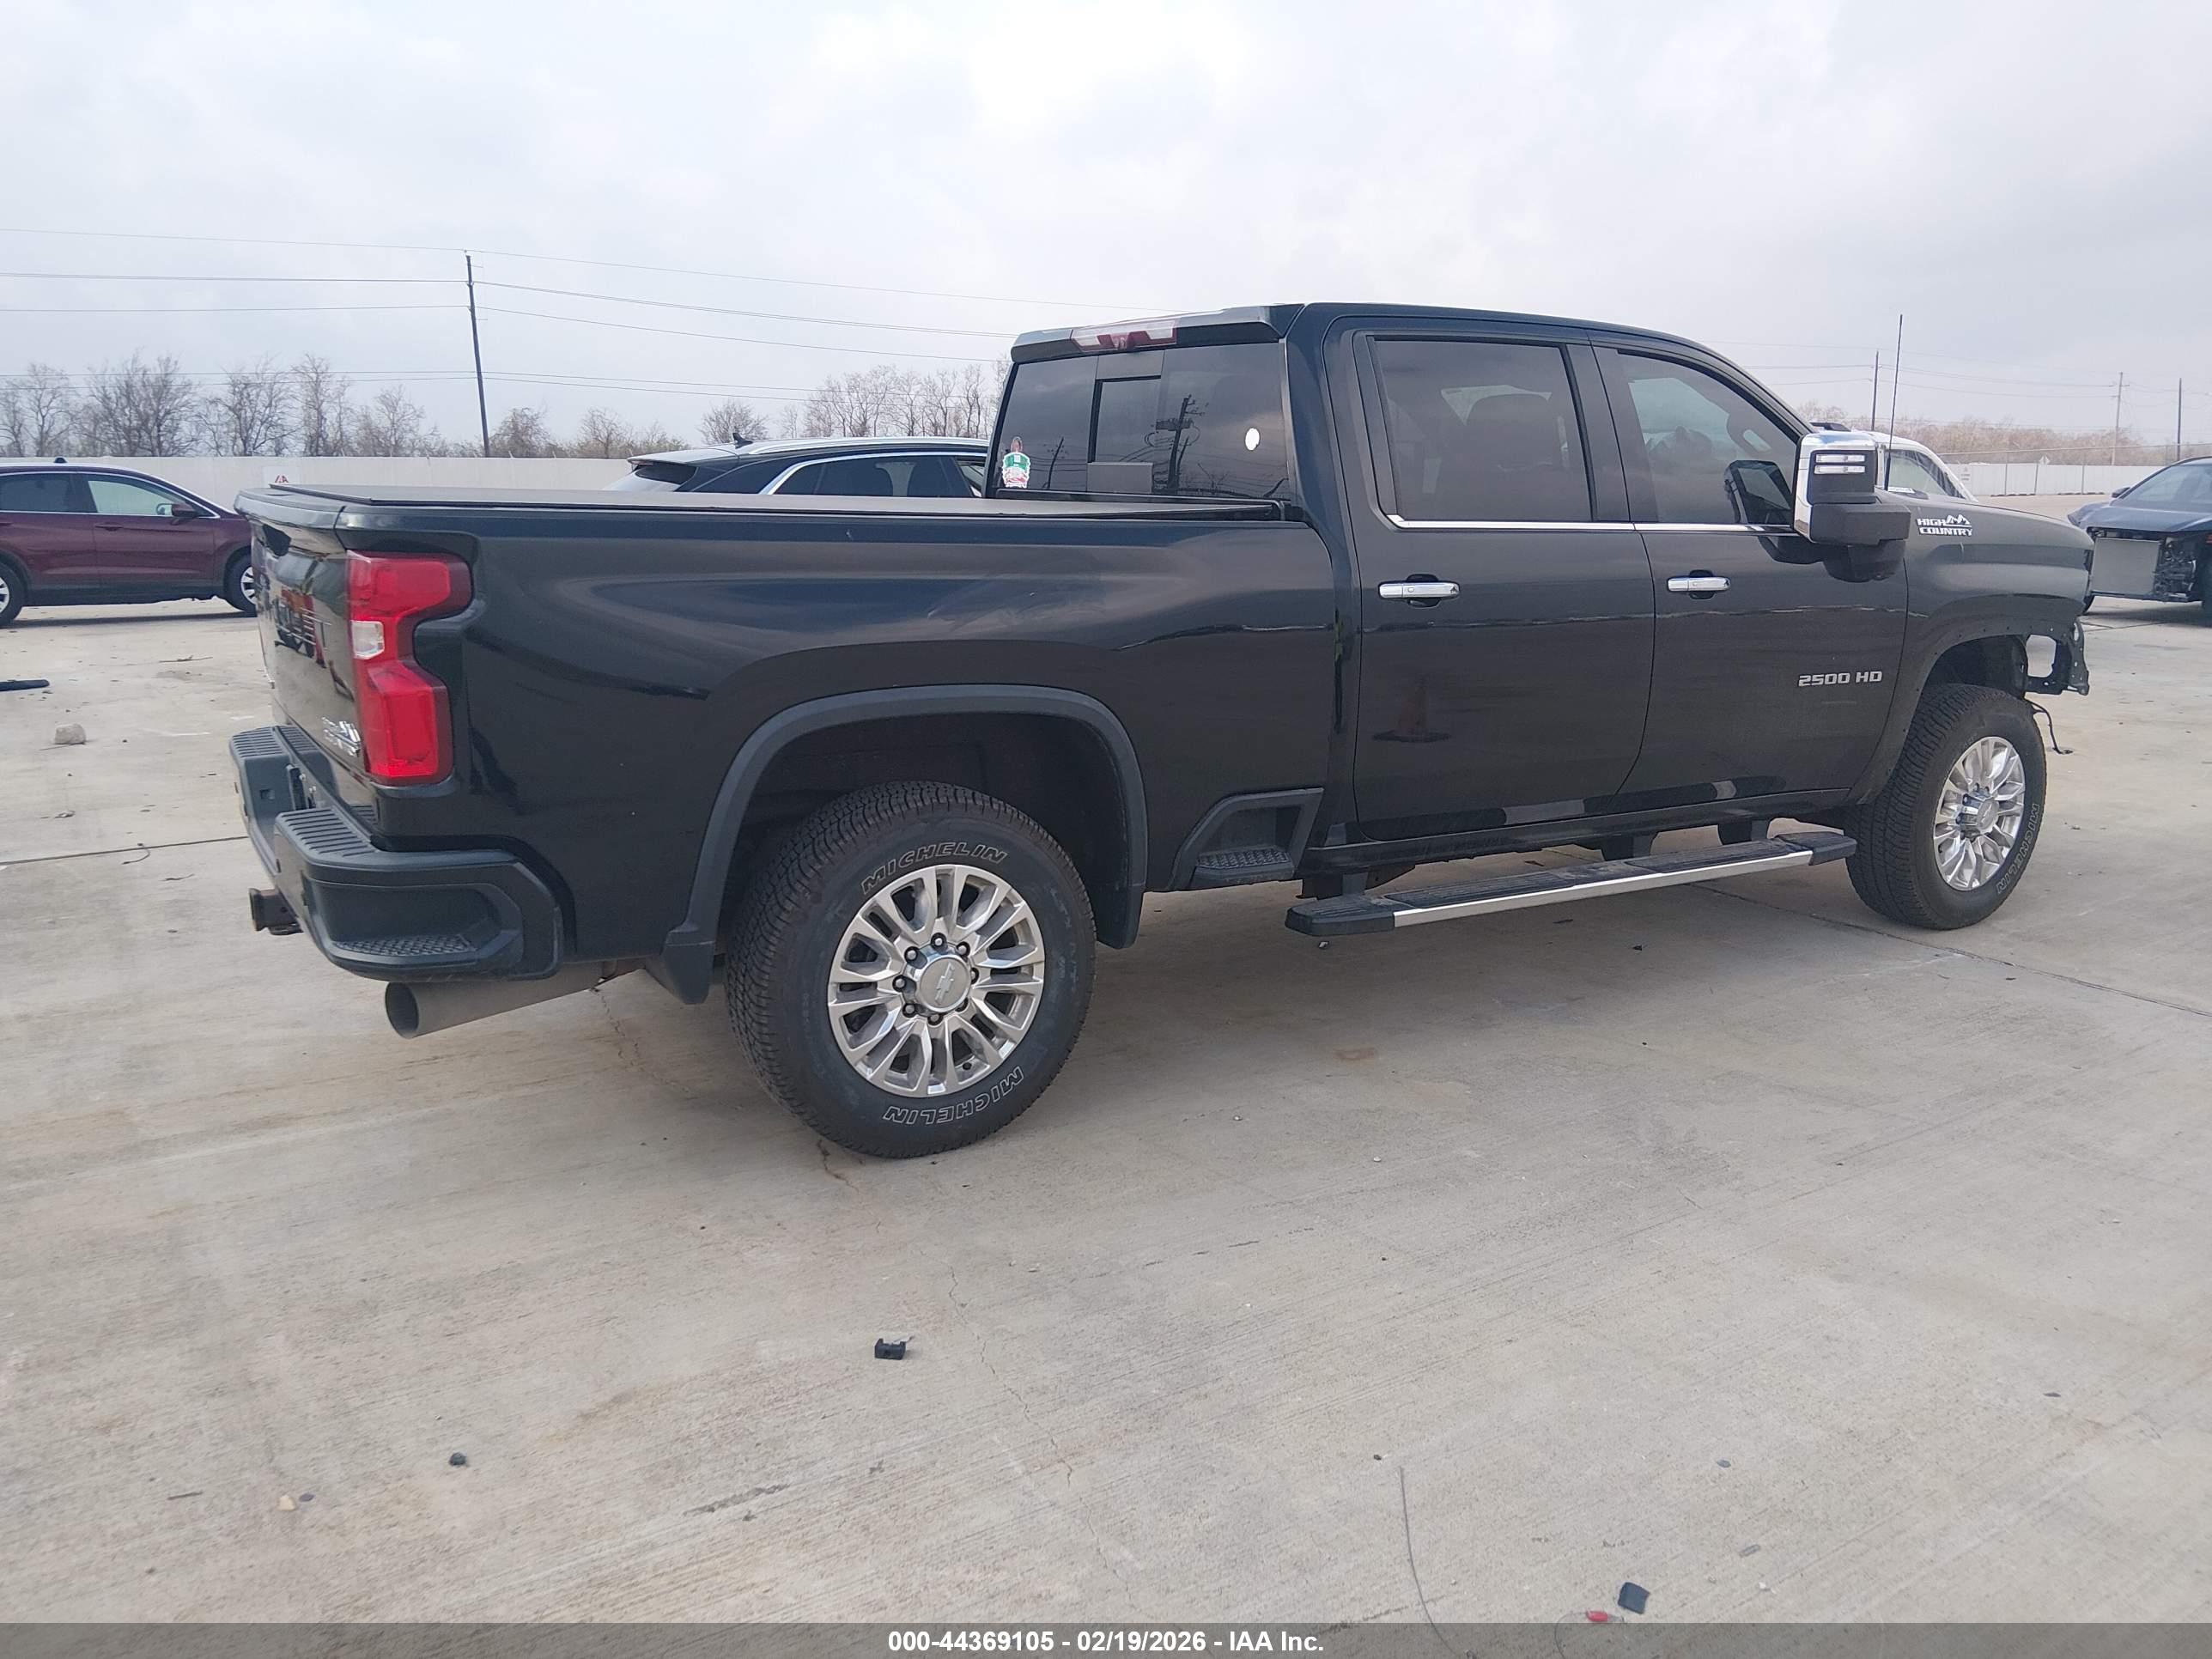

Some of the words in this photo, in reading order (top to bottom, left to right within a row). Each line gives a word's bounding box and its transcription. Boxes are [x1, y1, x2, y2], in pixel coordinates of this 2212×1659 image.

[1917, 518, 1947, 526] HIGH
[1918, 526, 1973, 537] COUNTRY
[1797, 672, 1850, 687] 2500
[1855, 671, 1883, 684] HD
[1996, 803, 2040, 894] MICHELIN
[860, 841, 1008, 896] MICHELIN
[882, 1066, 1024, 1125] MICHELIN
